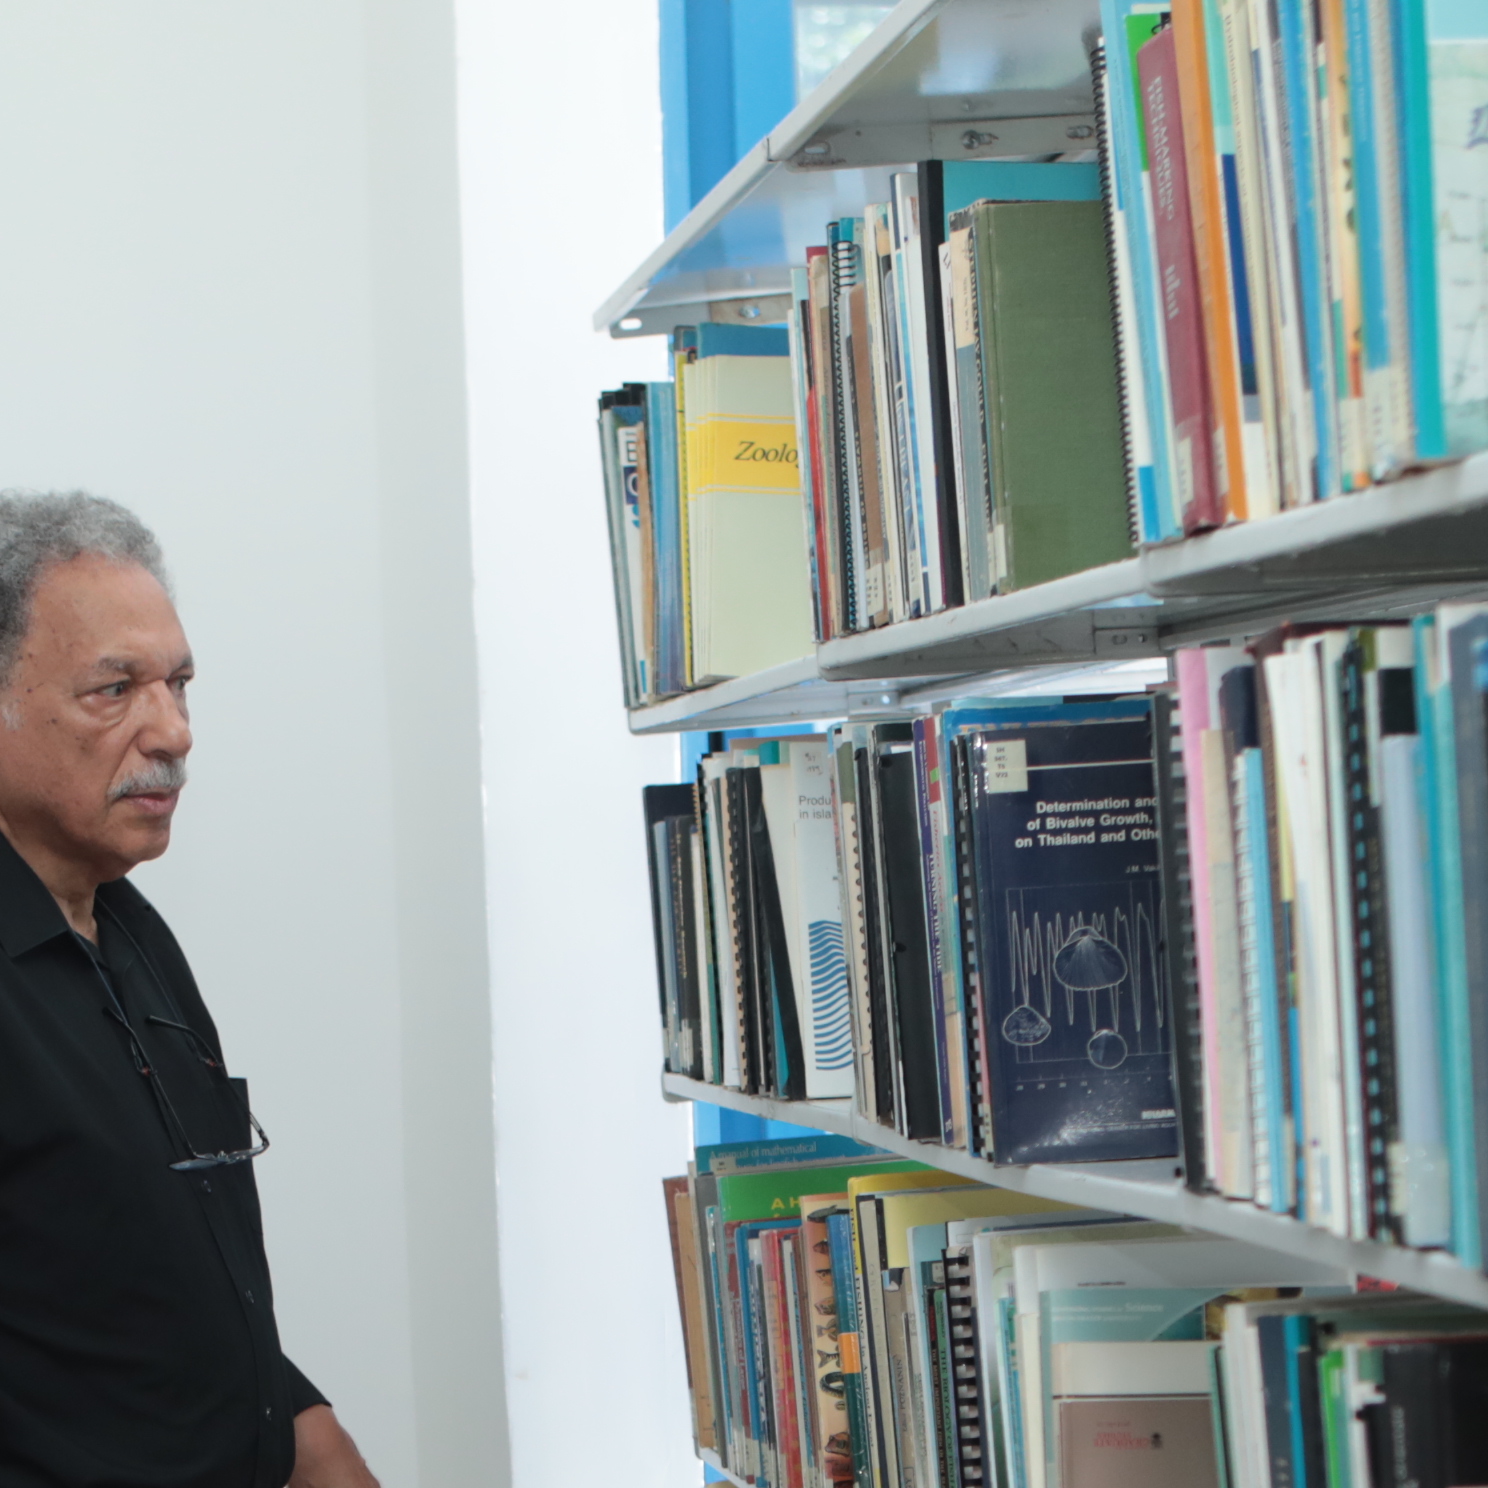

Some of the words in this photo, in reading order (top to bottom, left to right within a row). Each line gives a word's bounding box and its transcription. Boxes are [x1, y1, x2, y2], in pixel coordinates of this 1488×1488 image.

[734, 440, 799, 468] Zoolo
[799, 809, 809, 819] in
[1036, 797, 1130, 814] Determination
[1026, 819, 1040, 831] of
[1046, 816, 1095, 830] Bivalve
[1100, 812, 1153, 827] Growth,
[1015, 837, 1033, 848] on
[1038, 831, 1096, 847] Thailand
[1100, 830, 1126, 842] and
[719, 1147, 749, 1158] manual
[752, 1146, 760, 1157] of
[762, 1141, 817, 1156] mathematical
[771, 1198, 785, 1210] A
[942, 1377, 952, 1434] BIOLOGY
[946, 1437, 953, 1451] OF
